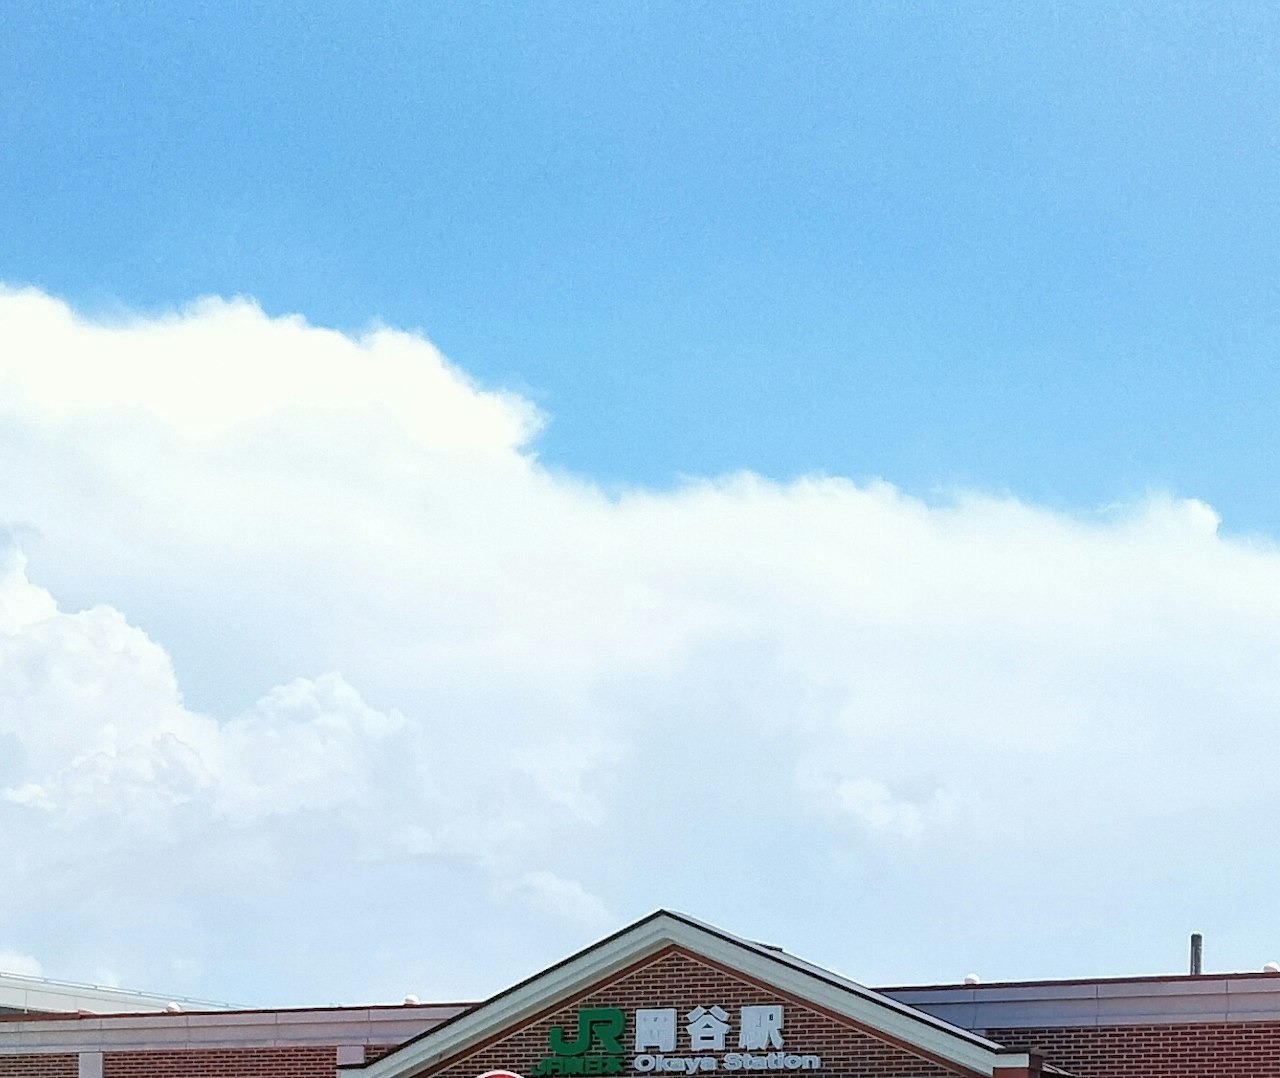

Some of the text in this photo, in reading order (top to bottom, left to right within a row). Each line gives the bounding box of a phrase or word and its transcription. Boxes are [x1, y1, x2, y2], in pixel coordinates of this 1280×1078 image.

[549, 1007, 625, 1056] JR
[634, 1005, 784, 1052] 岡谷駅
[530, 1055, 625, 1077] JR東日本
[633, 1051, 820, 1075] Okaya Station
